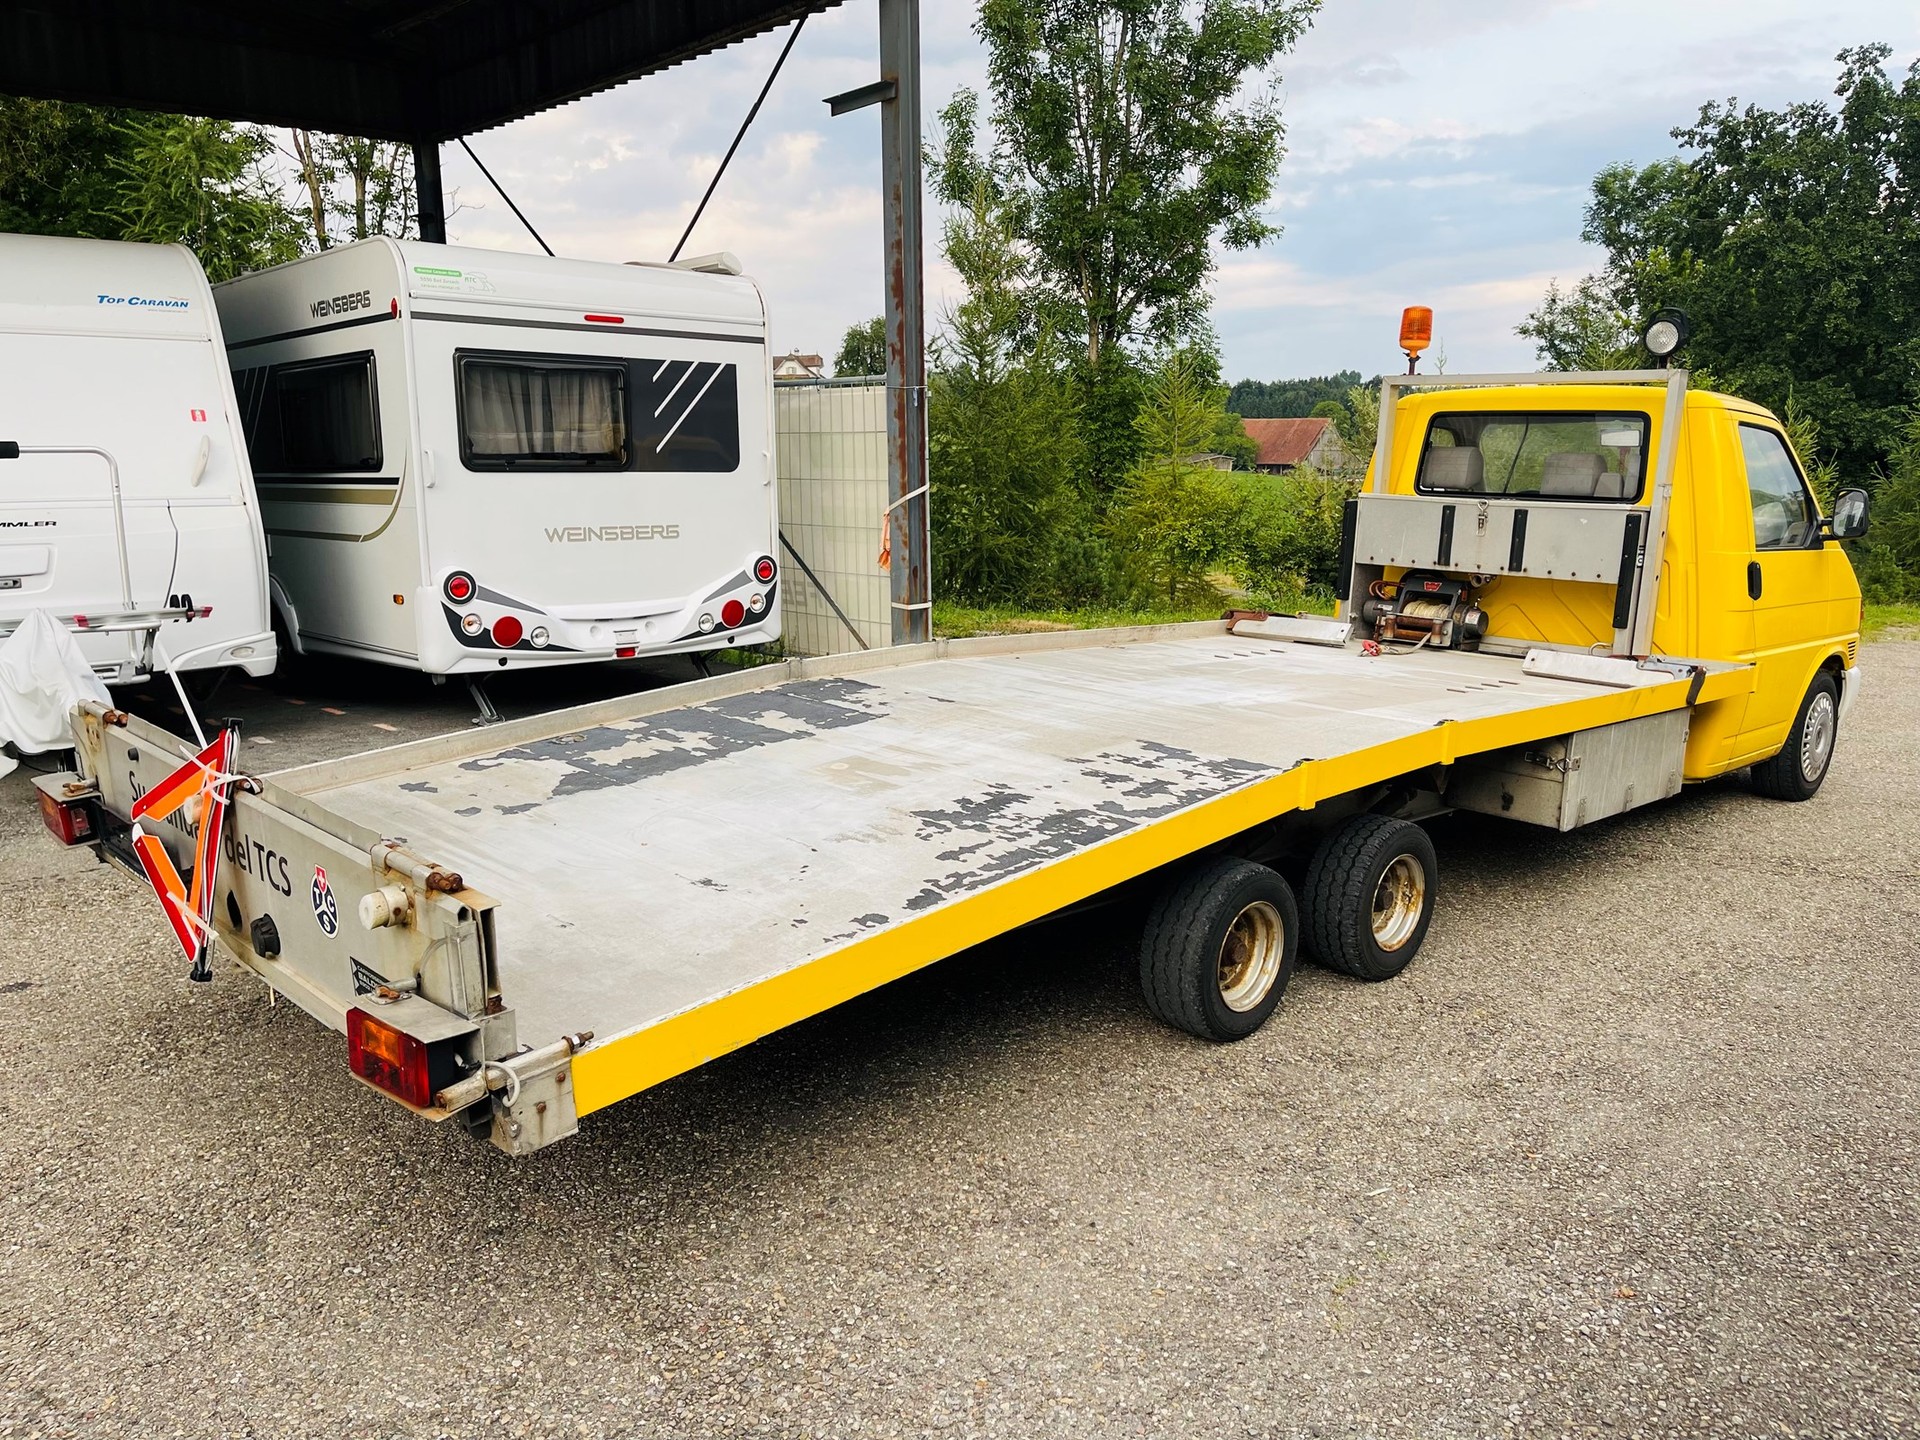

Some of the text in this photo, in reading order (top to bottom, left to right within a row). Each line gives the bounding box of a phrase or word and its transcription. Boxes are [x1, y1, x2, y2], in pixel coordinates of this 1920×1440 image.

[310, 290, 371, 319] WEINSBERG
[544, 524, 681, 543] WEINSBERG
[224, 824, 253, 875] del
[252, 840, 292, 897] TCS
